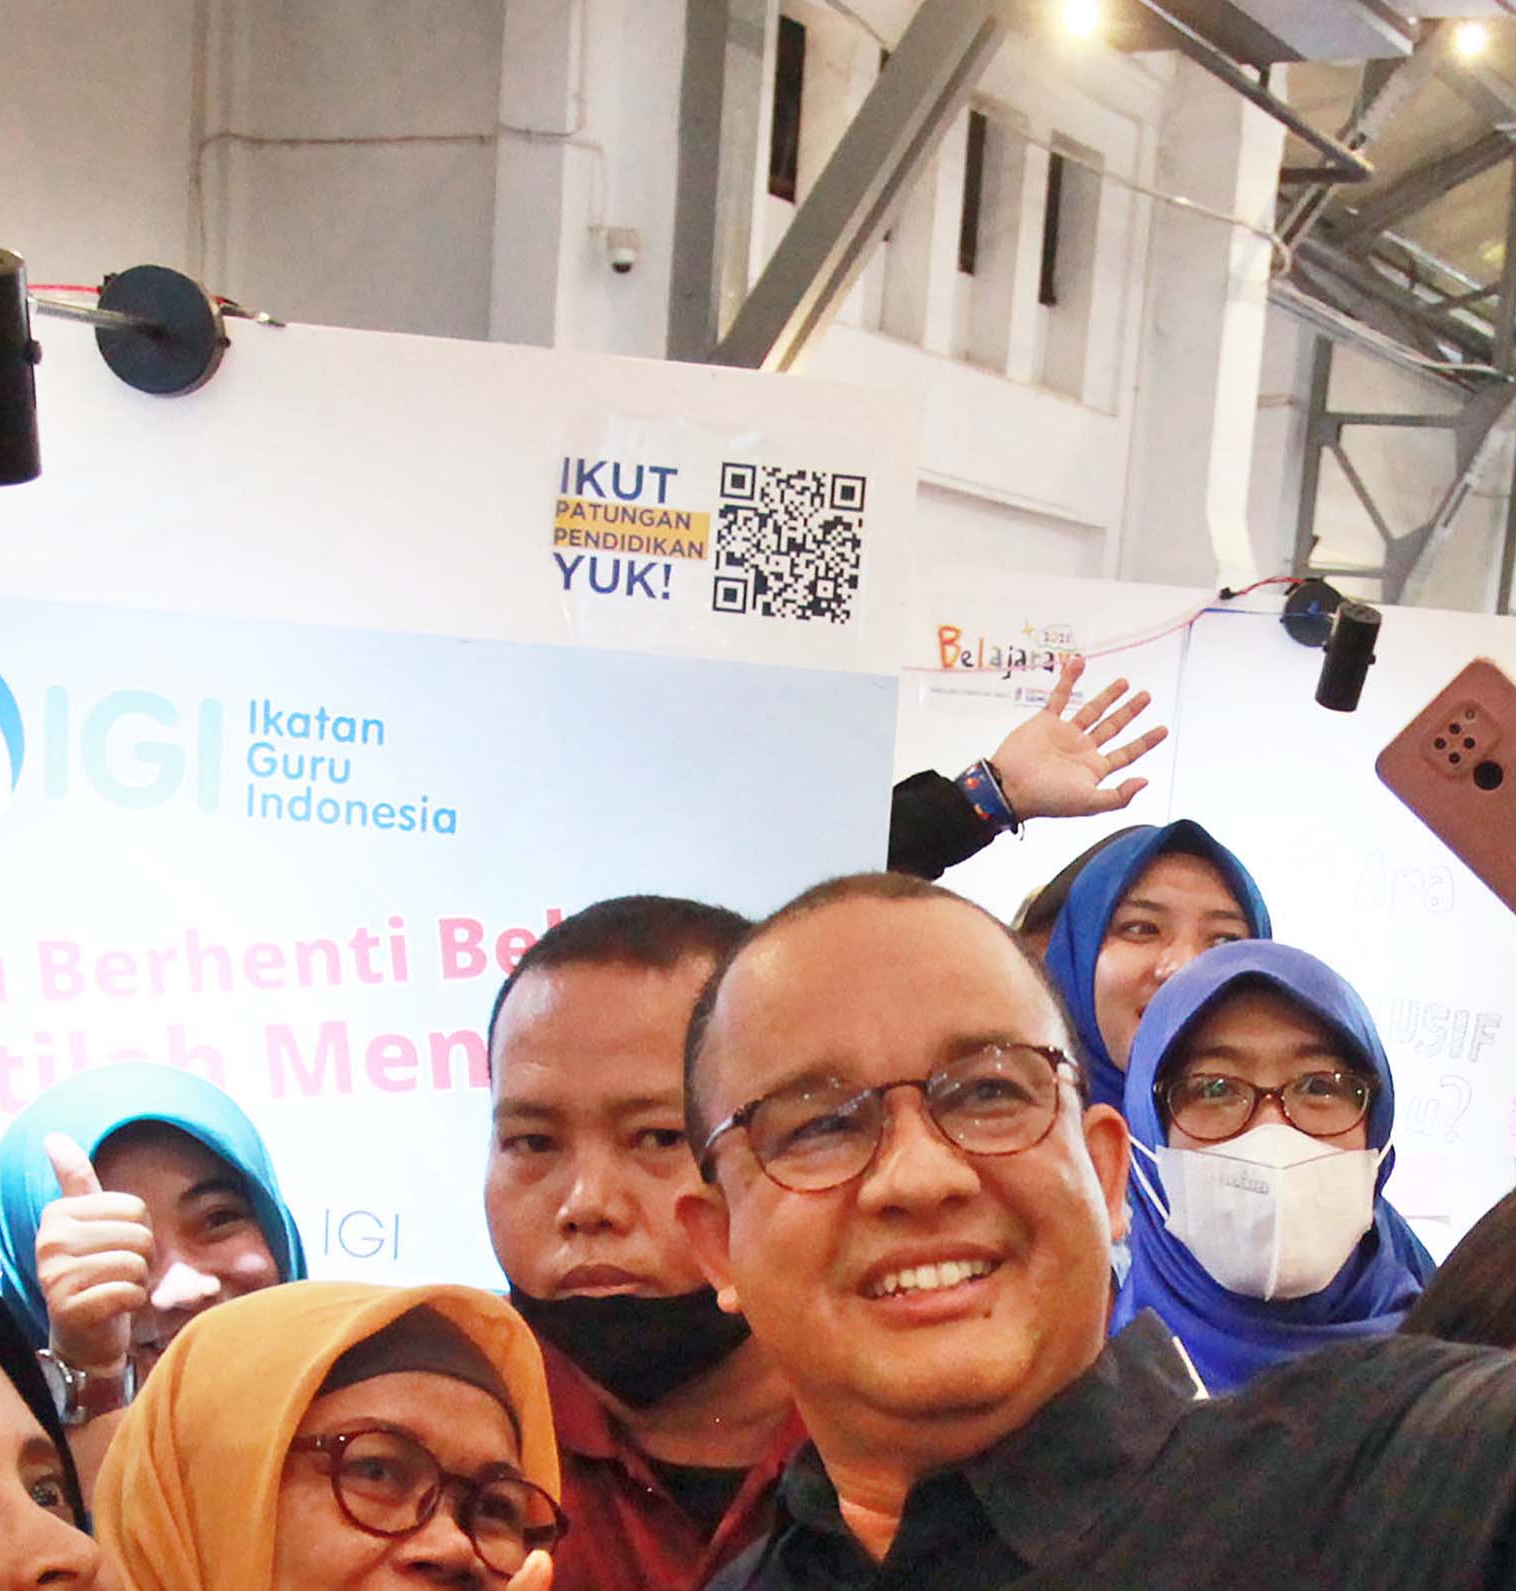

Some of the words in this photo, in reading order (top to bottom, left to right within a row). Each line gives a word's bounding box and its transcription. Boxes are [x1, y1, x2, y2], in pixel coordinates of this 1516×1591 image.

[560, 457, 679, 505] IKUT
[555, 500, 691, 531] PATUNGAN
[553, 529, 705, 560] PENDIDIKAN
[552, 553, 672, 601] YUK!
[247, 698, 386, 746] Ikatan
[42, 684, 225, 815] IGI
[246, 741, 352, 785] Guru
[246, 783, 459, 836] Indonesia
[38, 915, 407, 1002] Berhenti
[323, 1209, 401, 1261] IGI
